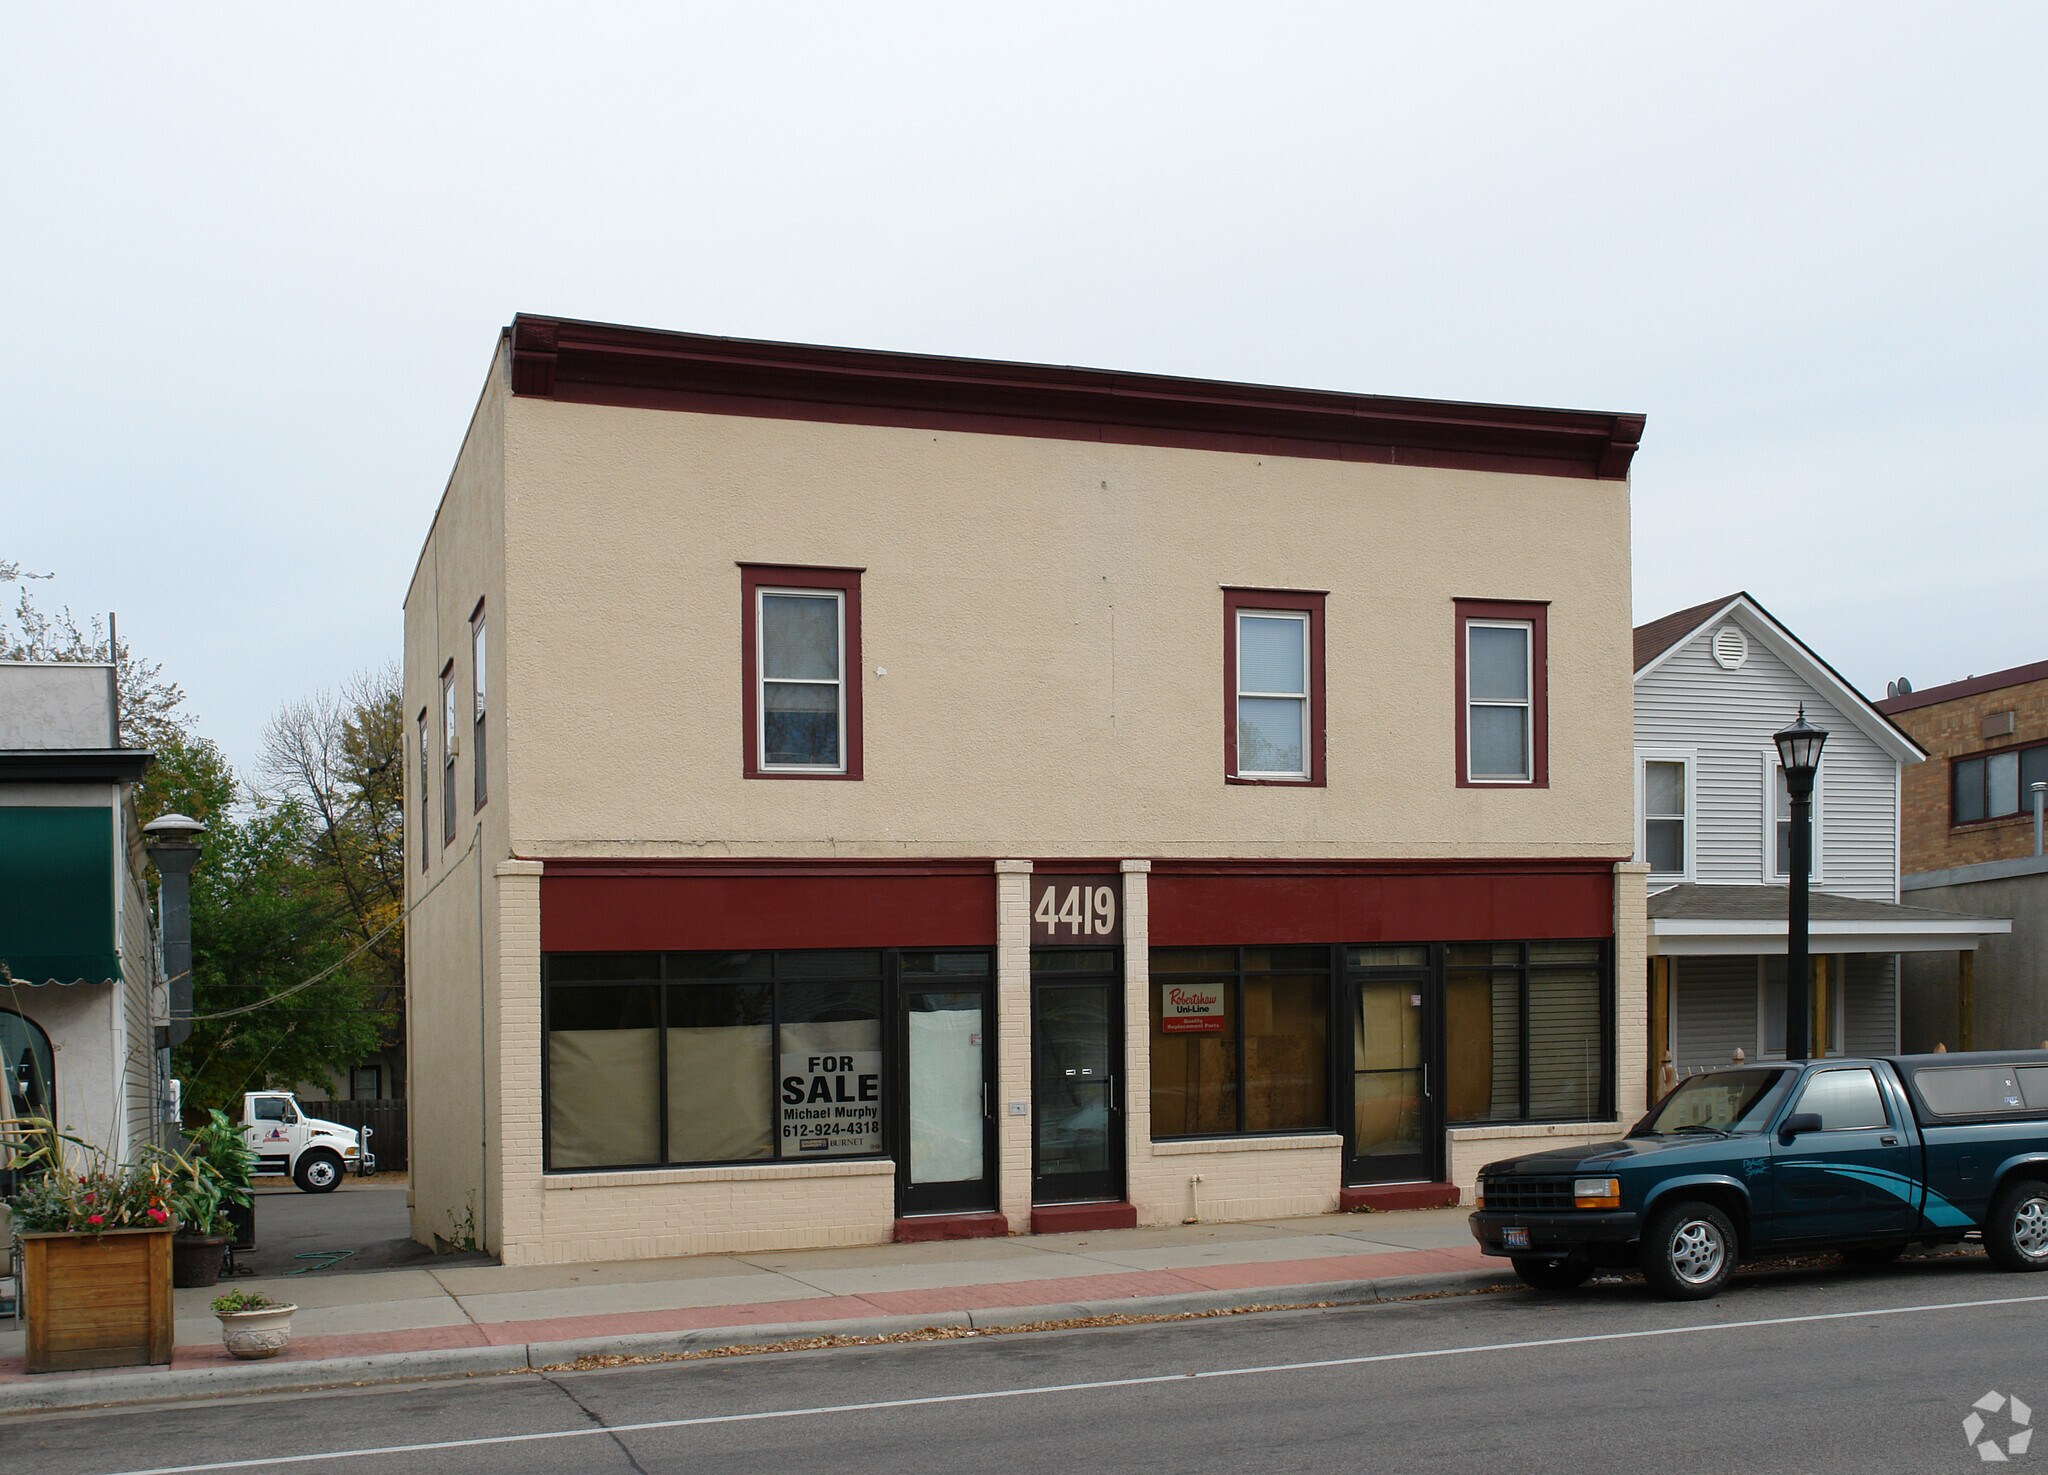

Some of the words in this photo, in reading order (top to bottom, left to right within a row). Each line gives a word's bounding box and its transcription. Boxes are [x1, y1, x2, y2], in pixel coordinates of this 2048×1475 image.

[1034, 885, 1116, 935] 4419
[1169, 988, 1217, 1006] Robertshaw
[808, 1056, 854, 1073] FOR
[782, 1074, 879, 1105] SALE
[784, 1107, 831, 1120] Michael
[835, 1106, 878, 1119] Murphy
[783, 1121, 879, 1138] 612-924-4318
[830, 1138, 864, 1147] BURNET
